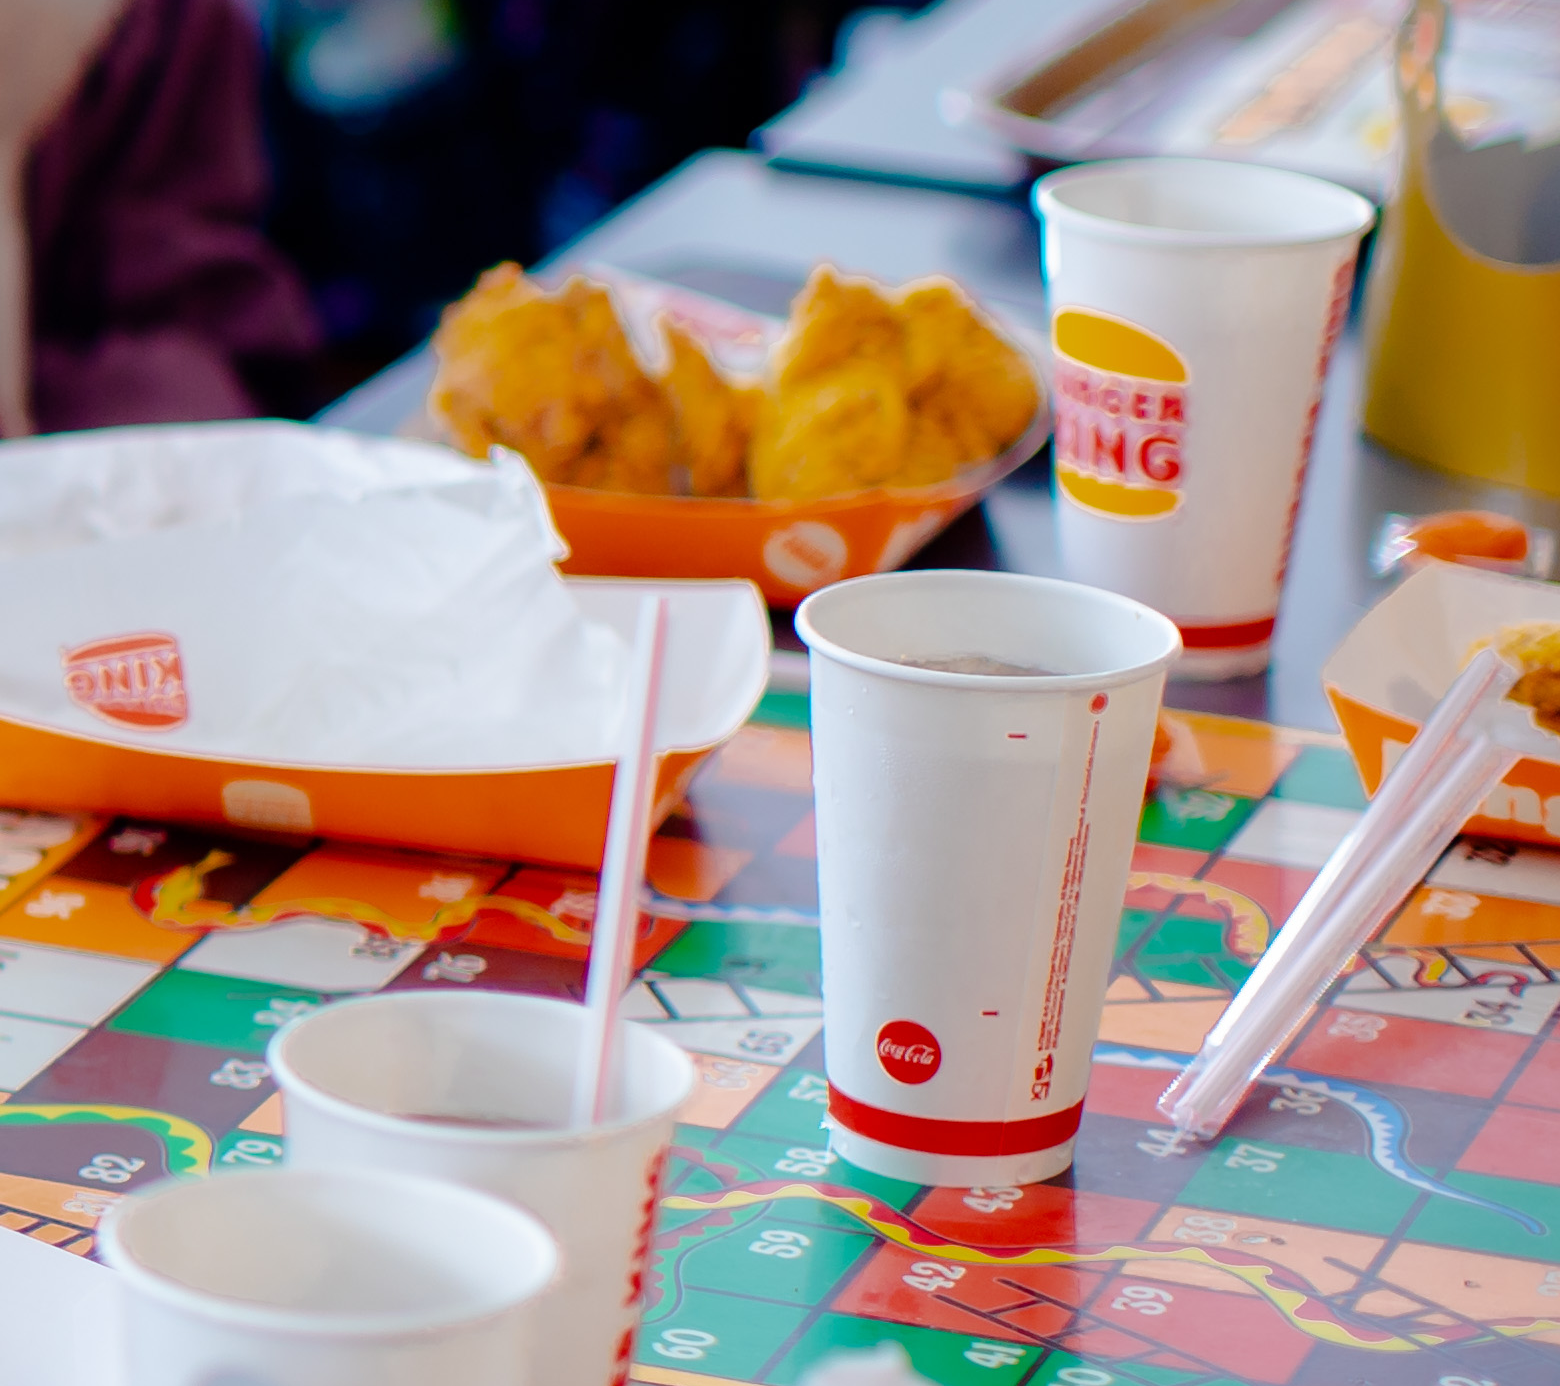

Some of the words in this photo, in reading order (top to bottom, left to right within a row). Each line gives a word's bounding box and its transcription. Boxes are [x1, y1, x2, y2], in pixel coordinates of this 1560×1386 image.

[1058, 419, 1182, 482] ING
[66, 653, 183, 701] KING
[222, 1138, 283, 1167] 79
[774, 1146, 840, 1178] 58
[1224, 1142, 1286, 1174] 37
[78, 1153, 146, 1185] 82
[747, 1228, 812, 1260] 59
[1173, 1215, 1237, 1245] 38
[902, 1260, 967, 1293] 42
[1110, 1285, 1174, 1316] 39
[651, 1327, 718, 1361] 60
[963, 1341, 1027, 1370] 41
